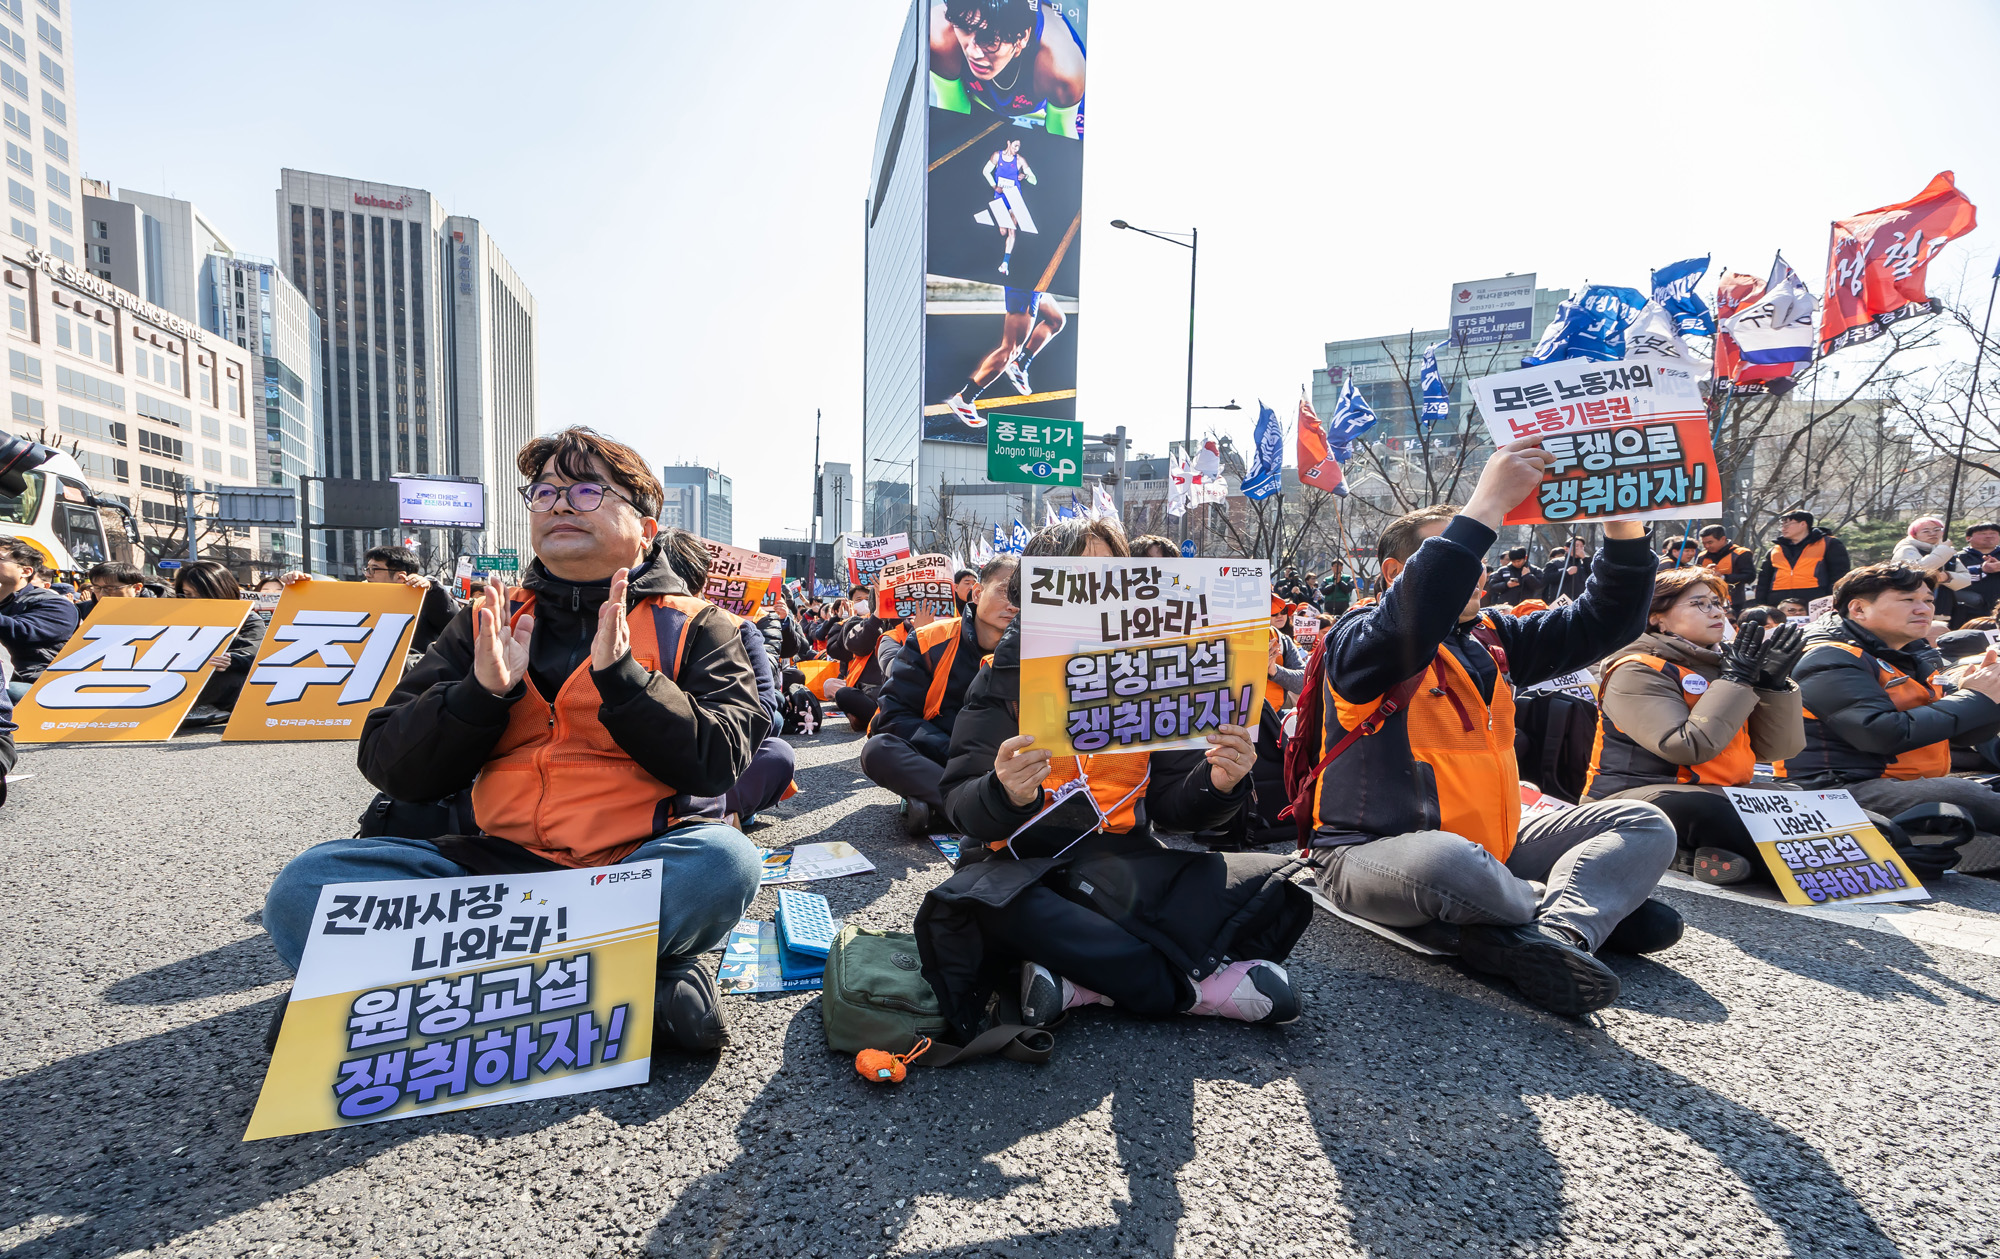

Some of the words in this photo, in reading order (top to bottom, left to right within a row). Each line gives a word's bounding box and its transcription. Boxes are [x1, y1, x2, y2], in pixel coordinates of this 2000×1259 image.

[354, 192, 404, 210] kobaco
[64, 264, 114, 300] SEOUL
[114, 287, 170, 325] FINANCE
[167, 316, 207, 343] CENTER
[1458, 318, 1478, 327] ETS
[1457, 326, 1490, 336] TOEFL
[1493, 382, 1555, 413] 모든
[1553, 364, 1653, 400] 노동자의
[995, 421, 1074, 447] 종로1가
[1507, 396, 1633, 439] 노동기본권
[994, 443, 1026, 459] Jongno
[1028, 446, 1056, 461] 1(il)-ga
[1038, 463, 1047, 476] 6
[1541, 424, 1684, 476] 투쟁으로
[1538, 463, 1706, 521] 쟁취하자!
[847, 537, 860, 547] 모든
[859, 537, 888, 549] 노동자의
[884, 564, 905, 578] 모든
[906, 556, 946, 571] 노동자의
[885, 569, 936, 588] 노동기본권
[1030, 566, 1163, 606] 진짜사장
[1231, 566, 1263, 577] 민주노총
[893, 583, 954, 600] 투쟁으로
[1100, 594, 1209, 643] 나와라!
[35, 625, 238, 709] 쟁
[249, 610, 416, 706] 취
[1065, 638, 1227, 703] 원청교섭
[56, 721, 140, 730] 전국금속노동조합
[279, 718, 352, 727] 전국금속노동조합
[1065, 684, 1253, 752] 쟁취하자!
[1732, 792, 1791, 815] 진짜사장
[1773, 809, 1833, 836] 나와라!
[1775, 833, 1870, 870] 원청교섭
[1793, 860, 1907, 902] 쟁취하자!
[322, 883, 510, 936] 진짜사장
[608, 868, 653, 884] 민주노총
[411, 906, 568, 971] 나와라!
[346, 952, 592, 1053] 원청교섭
[331, 1002, 631, 1119] 쟁취하자!
